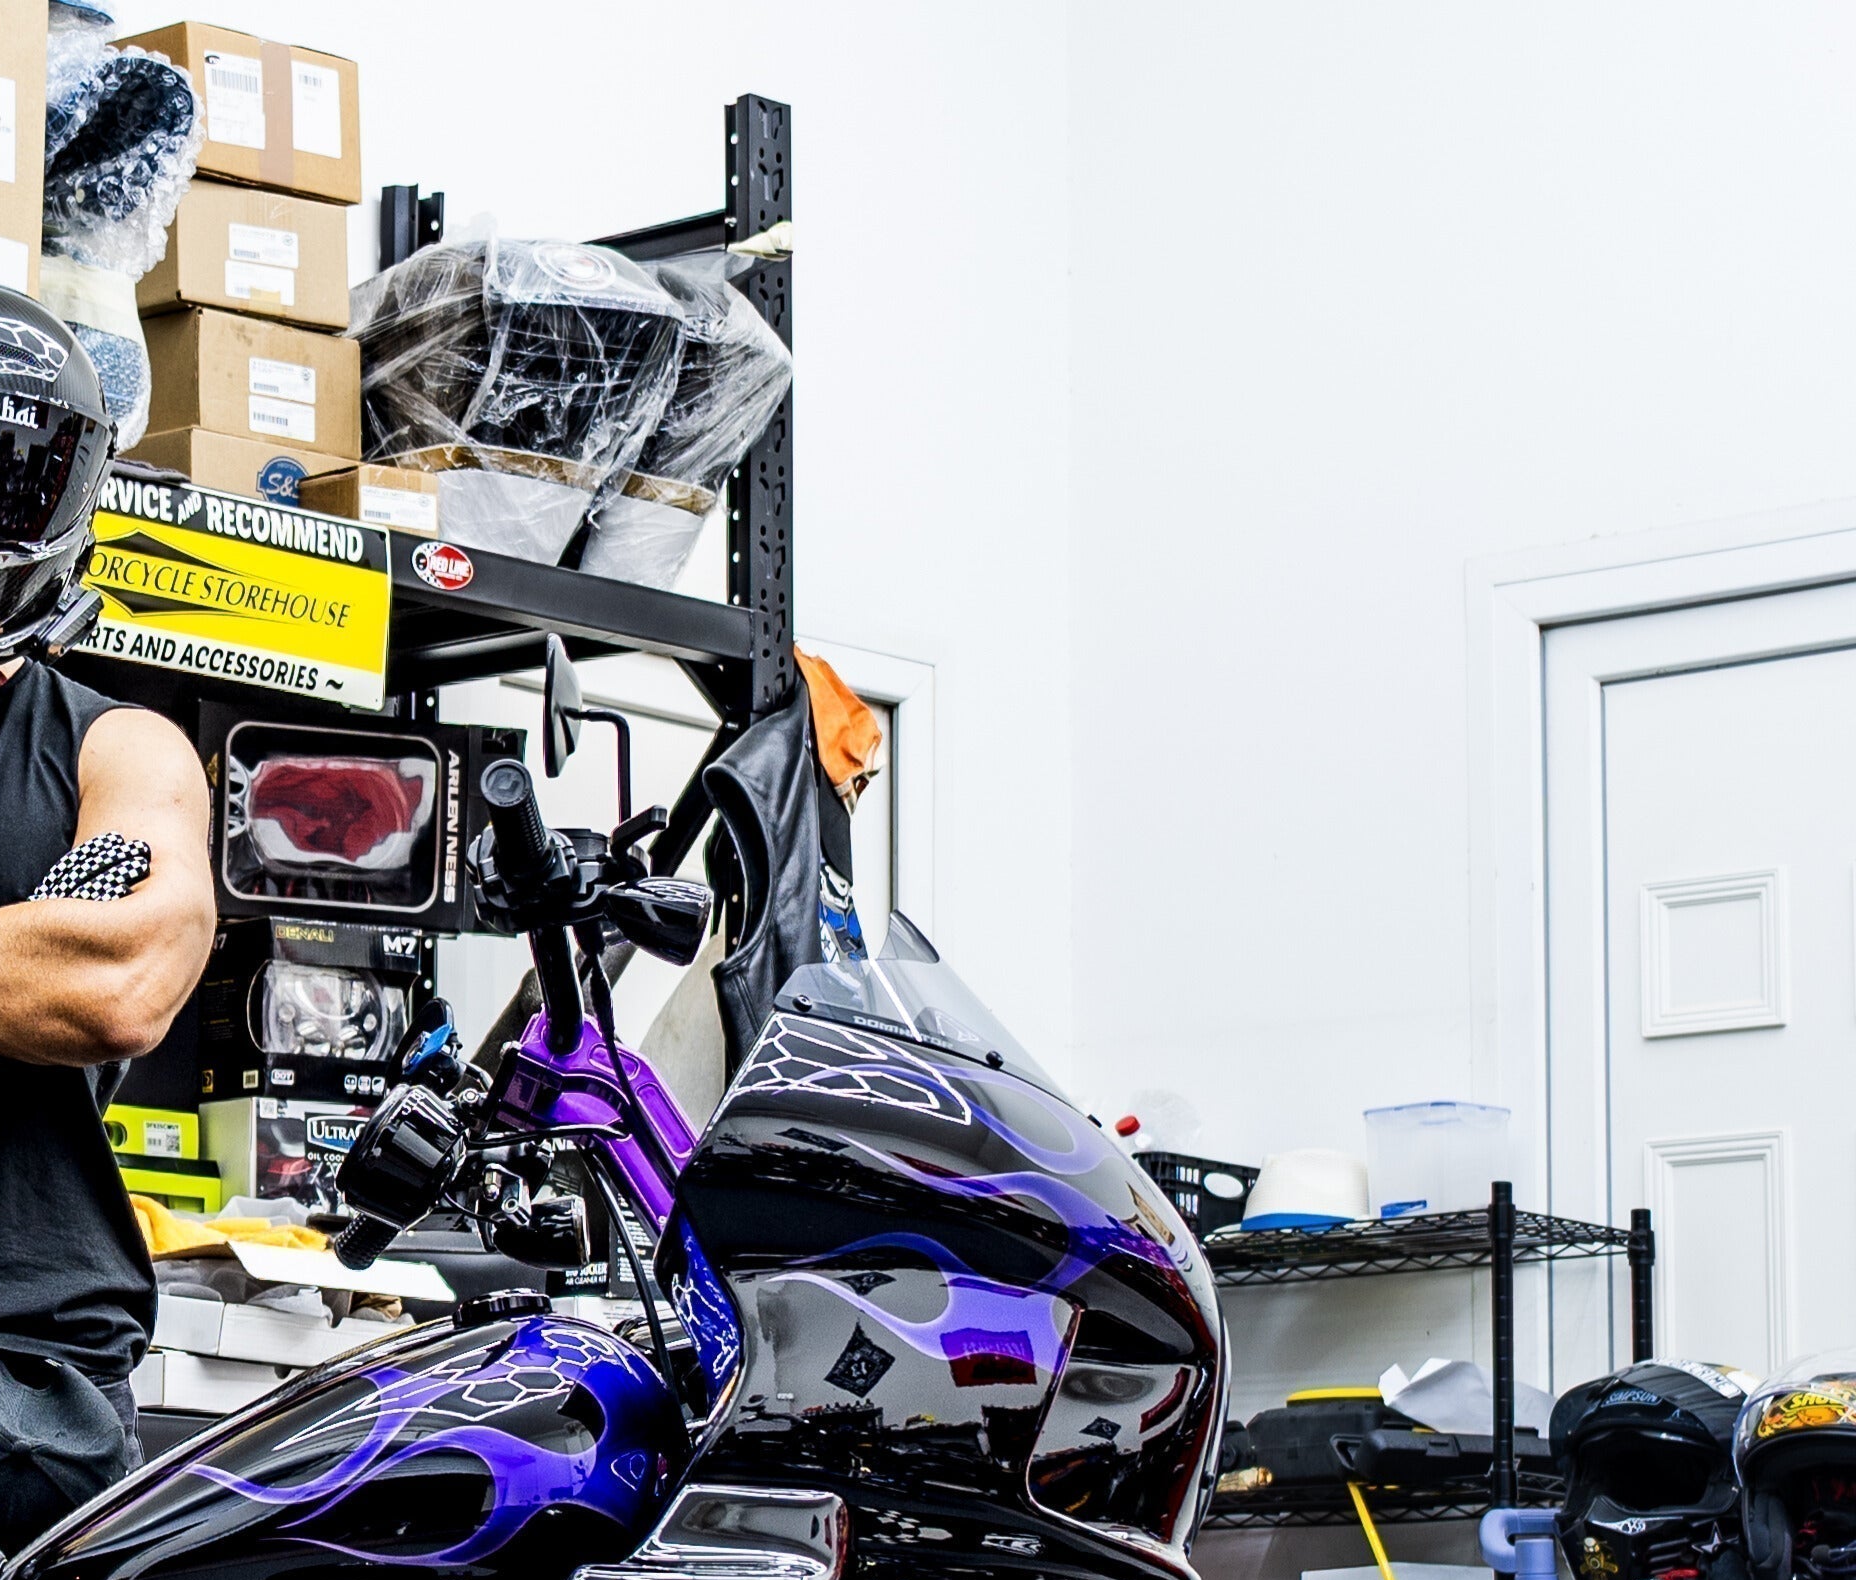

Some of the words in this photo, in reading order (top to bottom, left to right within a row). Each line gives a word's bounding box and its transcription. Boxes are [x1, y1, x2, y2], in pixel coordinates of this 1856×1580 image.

[177, 491, 202, 525] AND
[206, 495, 364, 563] RECOMMEND
[199, 574, 351, 629] STOREHOUSE
[129, 632, 177, 663] AND
[179, 643, 319, 690] ACCESSORIES
[447, 749, 461, 832] ARLEN
[443, 836, 459, 904] NESS
[275, 925, 335, 943] DENALI
[382, 934, 417, 955] M7
[307, 1151, 323, 1161] OIL
